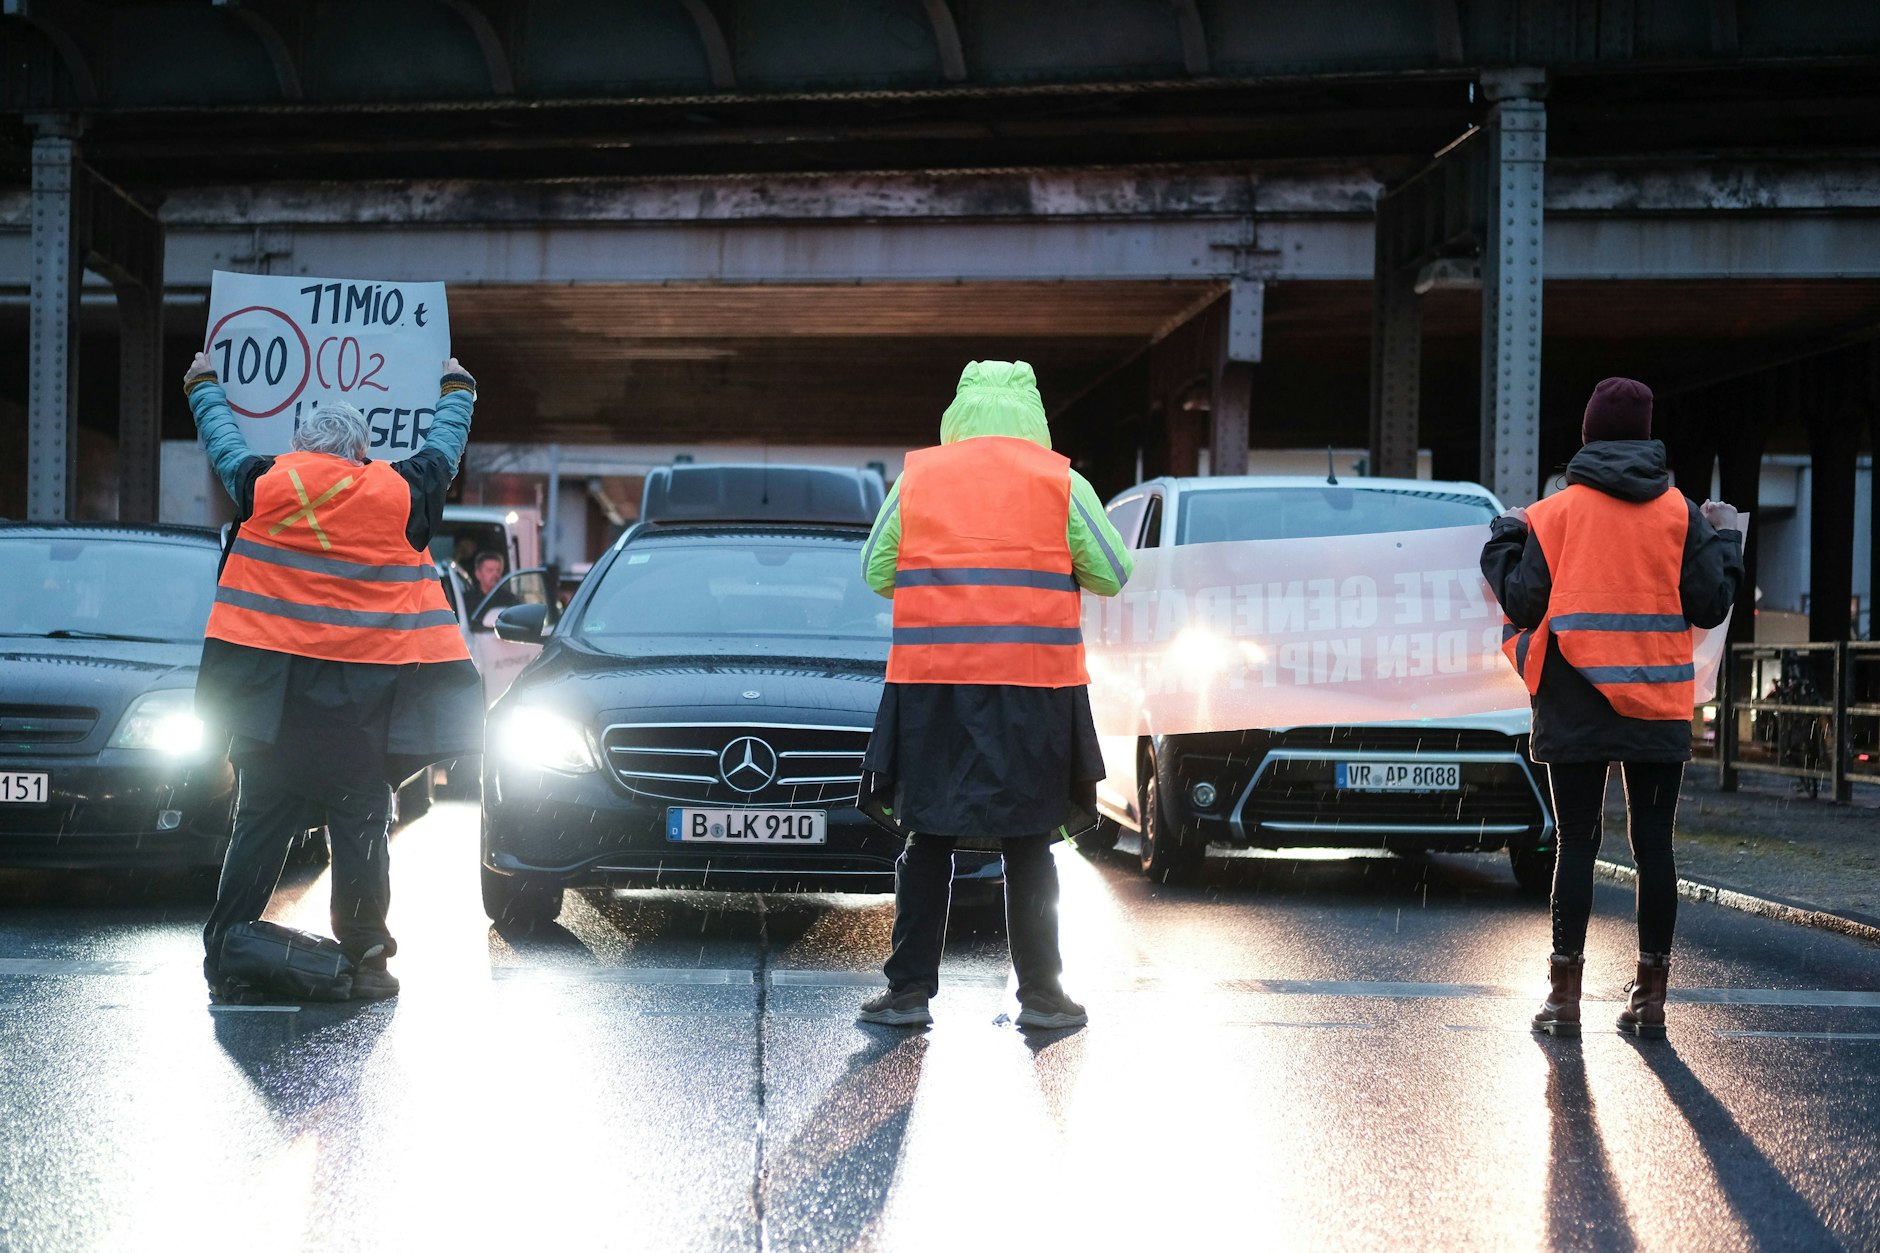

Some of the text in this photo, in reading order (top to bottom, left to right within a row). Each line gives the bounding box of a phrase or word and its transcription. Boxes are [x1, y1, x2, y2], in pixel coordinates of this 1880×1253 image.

[214, 336, 288, 385] 100
[316, 336, 389, 392] CO2
[1, 775, 42, 801] 151
[1349, 765, 1457, 786] VR AP 8088
[692, 813, 814, 839] B LK 910
